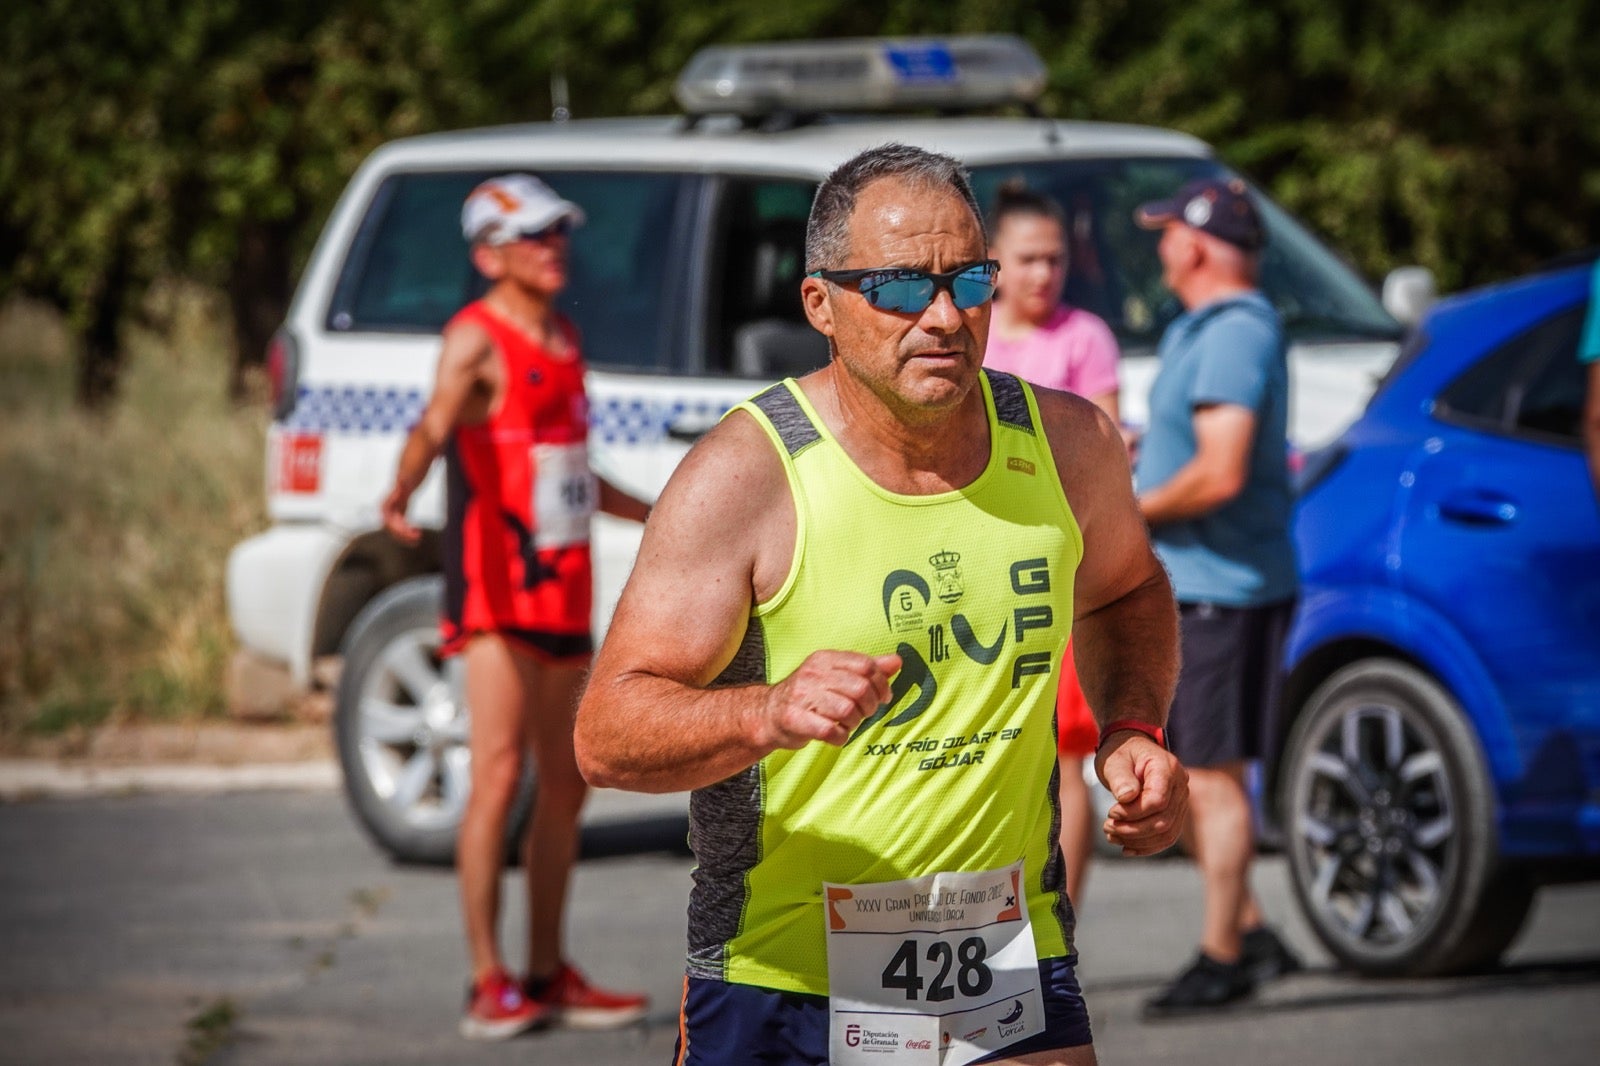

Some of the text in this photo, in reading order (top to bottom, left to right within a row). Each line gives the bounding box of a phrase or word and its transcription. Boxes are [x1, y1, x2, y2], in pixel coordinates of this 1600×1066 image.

[864, 743, 902, 756] XXX
[918, 750, 986, 771] GÓJAR
[855, 898, 881, 913] XXXV
[945, 892, 957, 905] DE
[960, 889, 986, 905] FONDO
[943, 908, 965, 921] LORCA
[881, 936, 994, 1003] 428
[862, 1030, 899, 1039] Diputación
[997, 1024, 1025, 1039] Lorca
[870, 1038, 899, 1046] Granada
